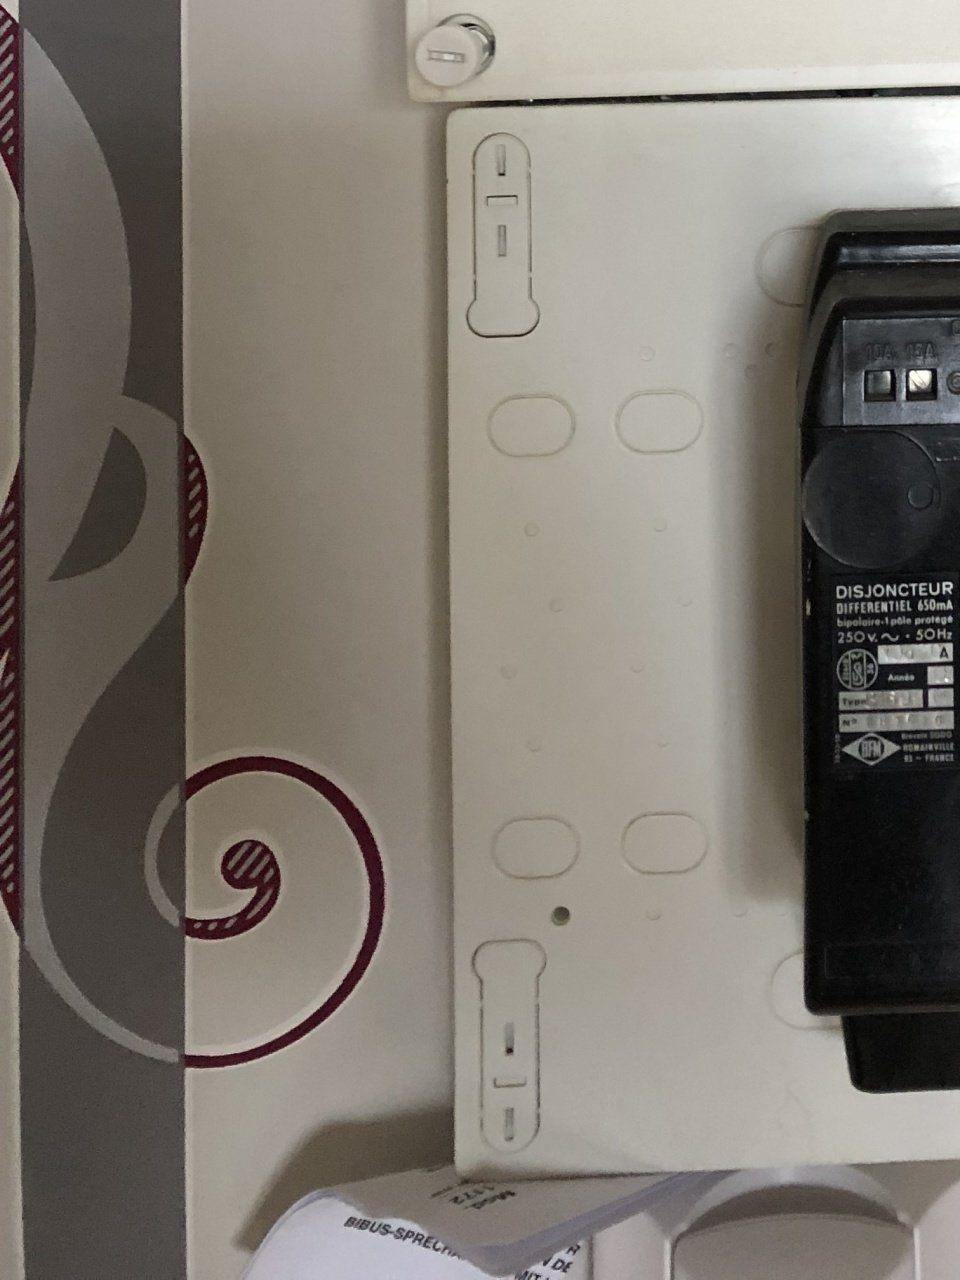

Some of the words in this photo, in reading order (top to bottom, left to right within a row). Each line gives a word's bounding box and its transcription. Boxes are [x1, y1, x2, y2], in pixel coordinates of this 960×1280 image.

[836, 581, 954, 599] DISJONCTEUR
[836, 600, 912, 615] DIFFERENTIEL
[917, 599, 954, 612] 650mA
[939, 646, 949, 659] A
